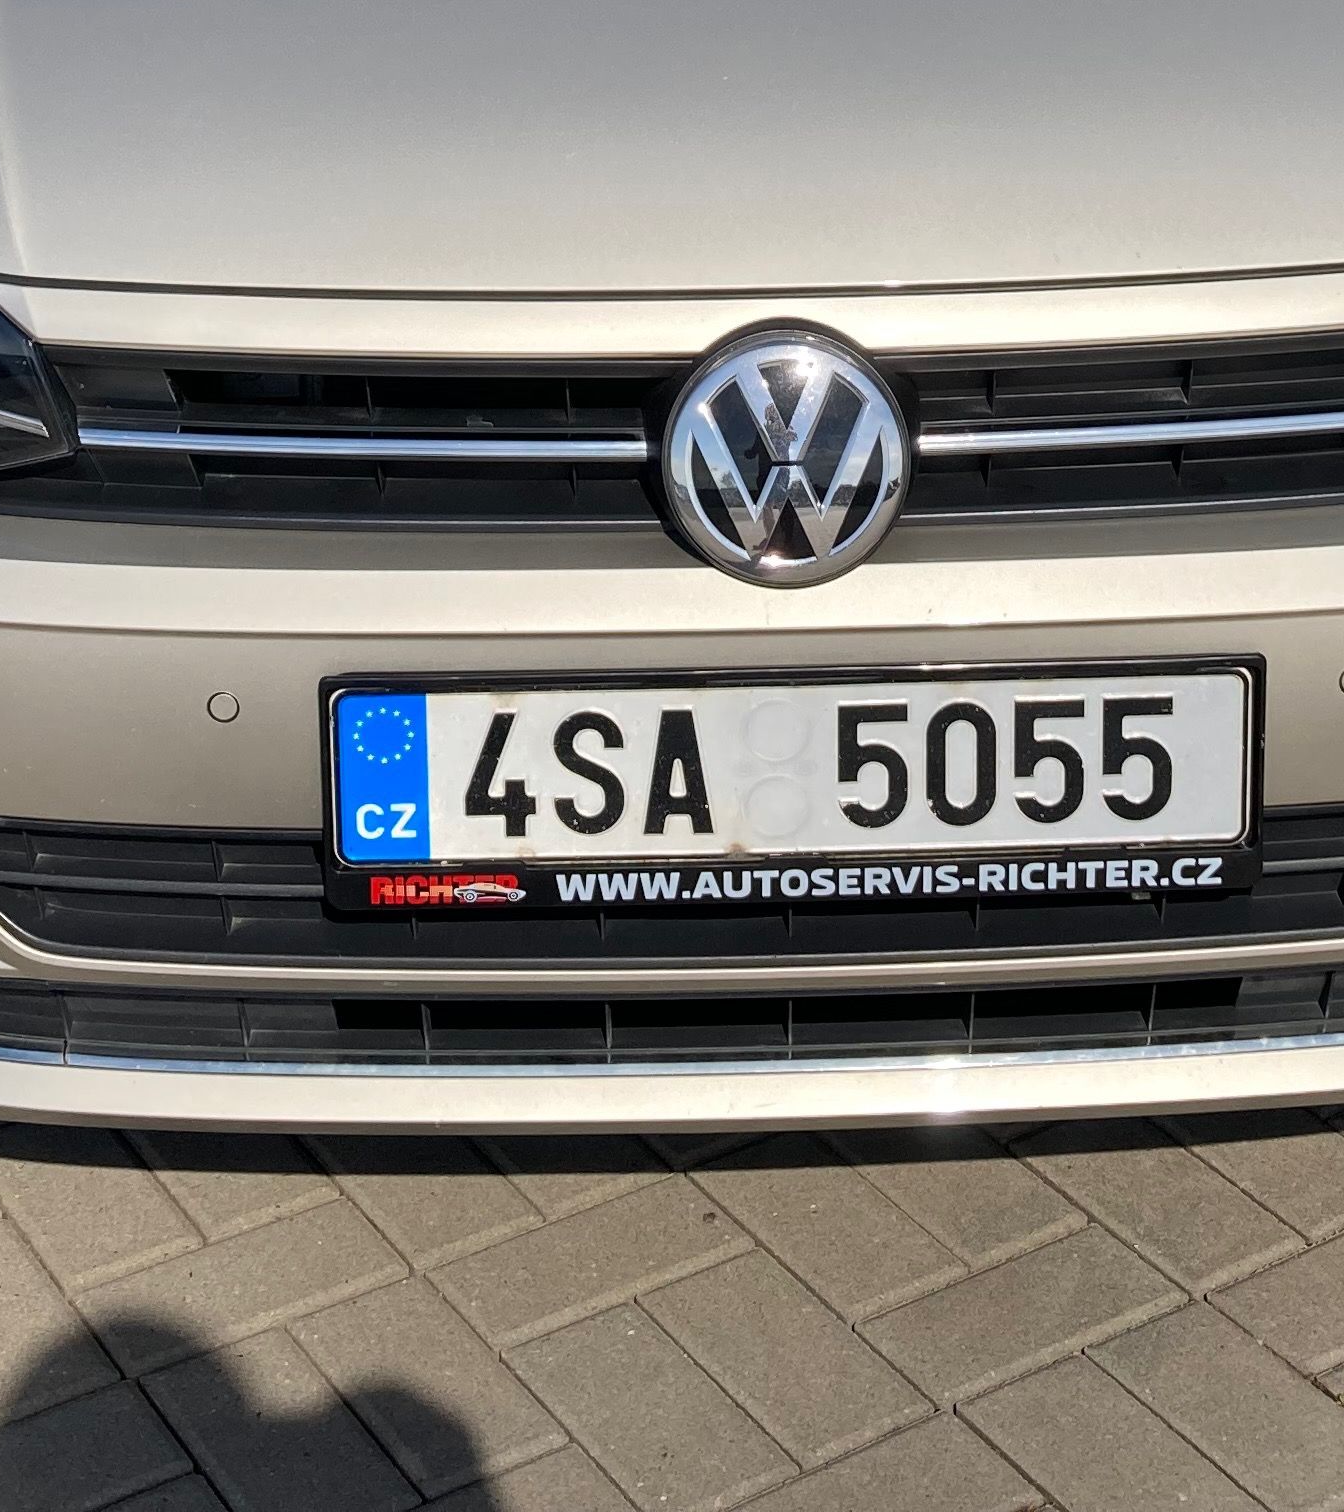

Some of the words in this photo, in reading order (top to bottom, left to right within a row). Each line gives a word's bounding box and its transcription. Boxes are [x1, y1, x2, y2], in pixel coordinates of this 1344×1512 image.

[676, 348, 896, 570] VW
[465, 708, 715, 837] 4SA
[838, 695, 1175, 829] 5055
[355, 803, 418, 840] CZ
[555, 856, 1224, 901] WWW.AUTOSERVIS-RICHTER.CZ
